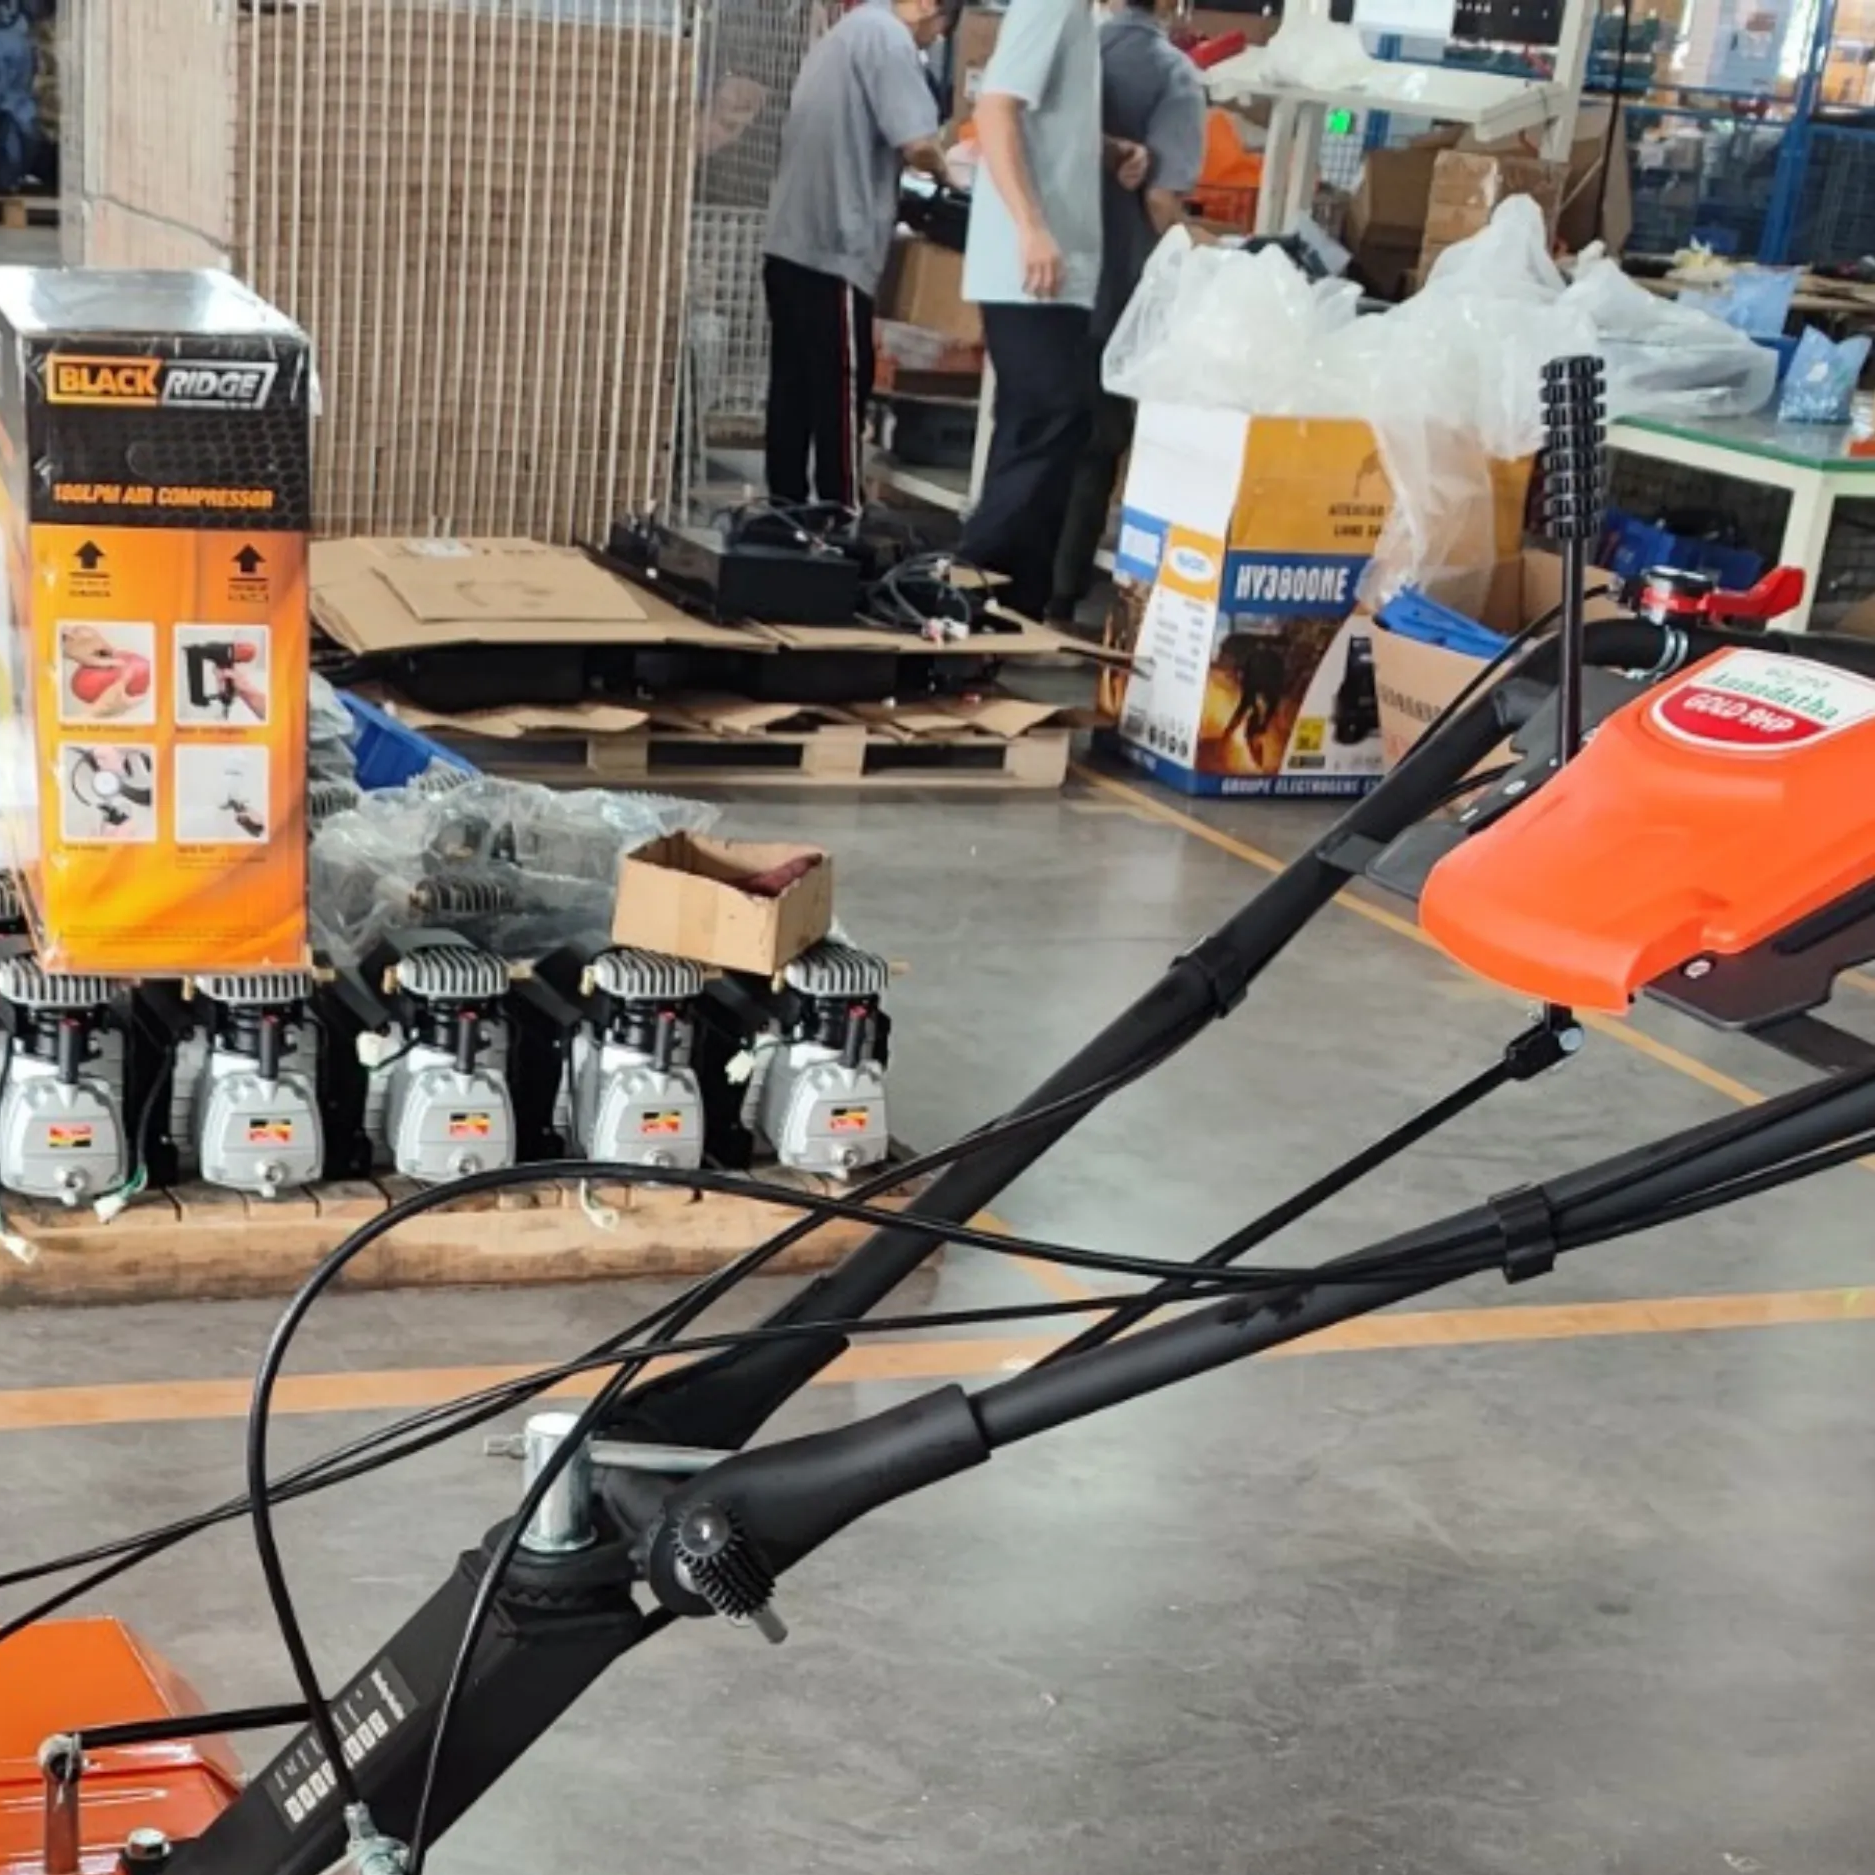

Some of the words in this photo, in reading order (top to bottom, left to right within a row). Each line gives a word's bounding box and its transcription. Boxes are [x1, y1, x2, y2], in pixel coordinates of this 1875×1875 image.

[58, 363, 157, 395] BLACK
[172, 369, 260, 398] RIDGE
[122, 485, 155, 505] AIR
[157, 486, 274, 508] COMPRESSOR
[1682, 692, 1749, 719] GOLD
